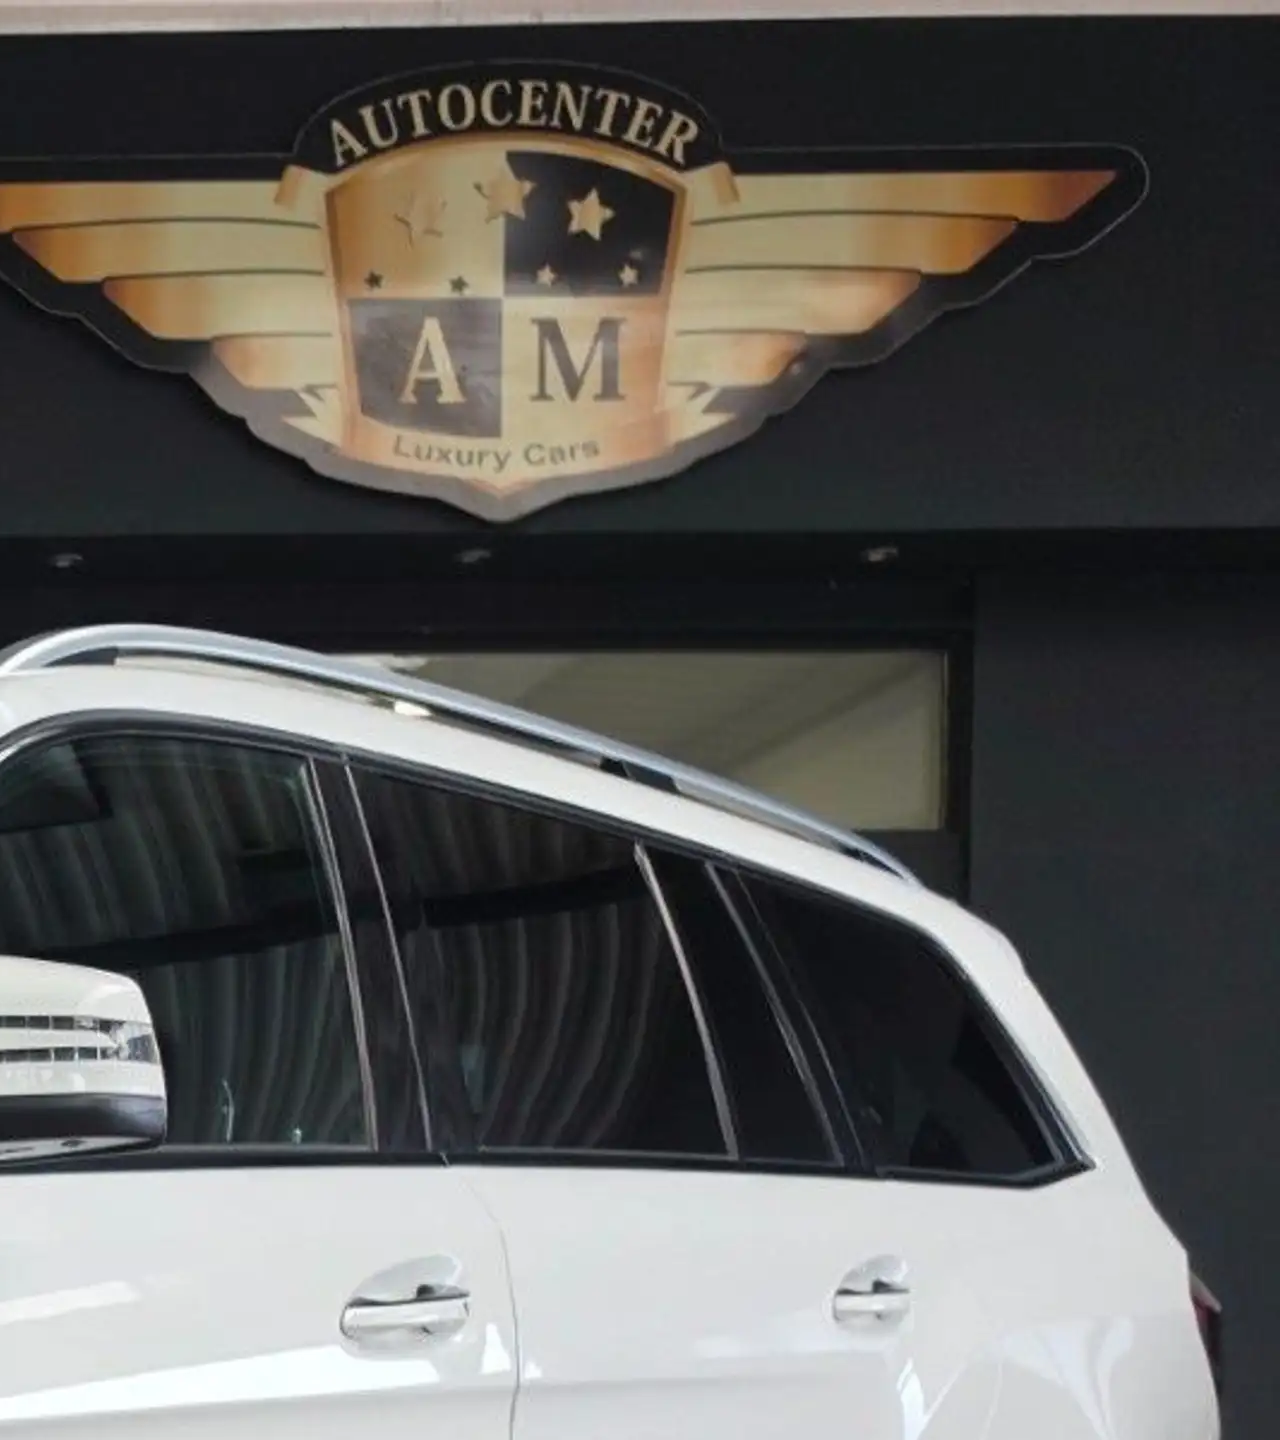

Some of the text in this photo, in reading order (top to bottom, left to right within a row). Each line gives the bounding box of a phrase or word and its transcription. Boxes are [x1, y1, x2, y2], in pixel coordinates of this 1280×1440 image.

[329, 79, 699, 166] AUTOCENTER
[399, 315, 628, 405] A M
[392, 434, 601, 474] Luxury Cars
